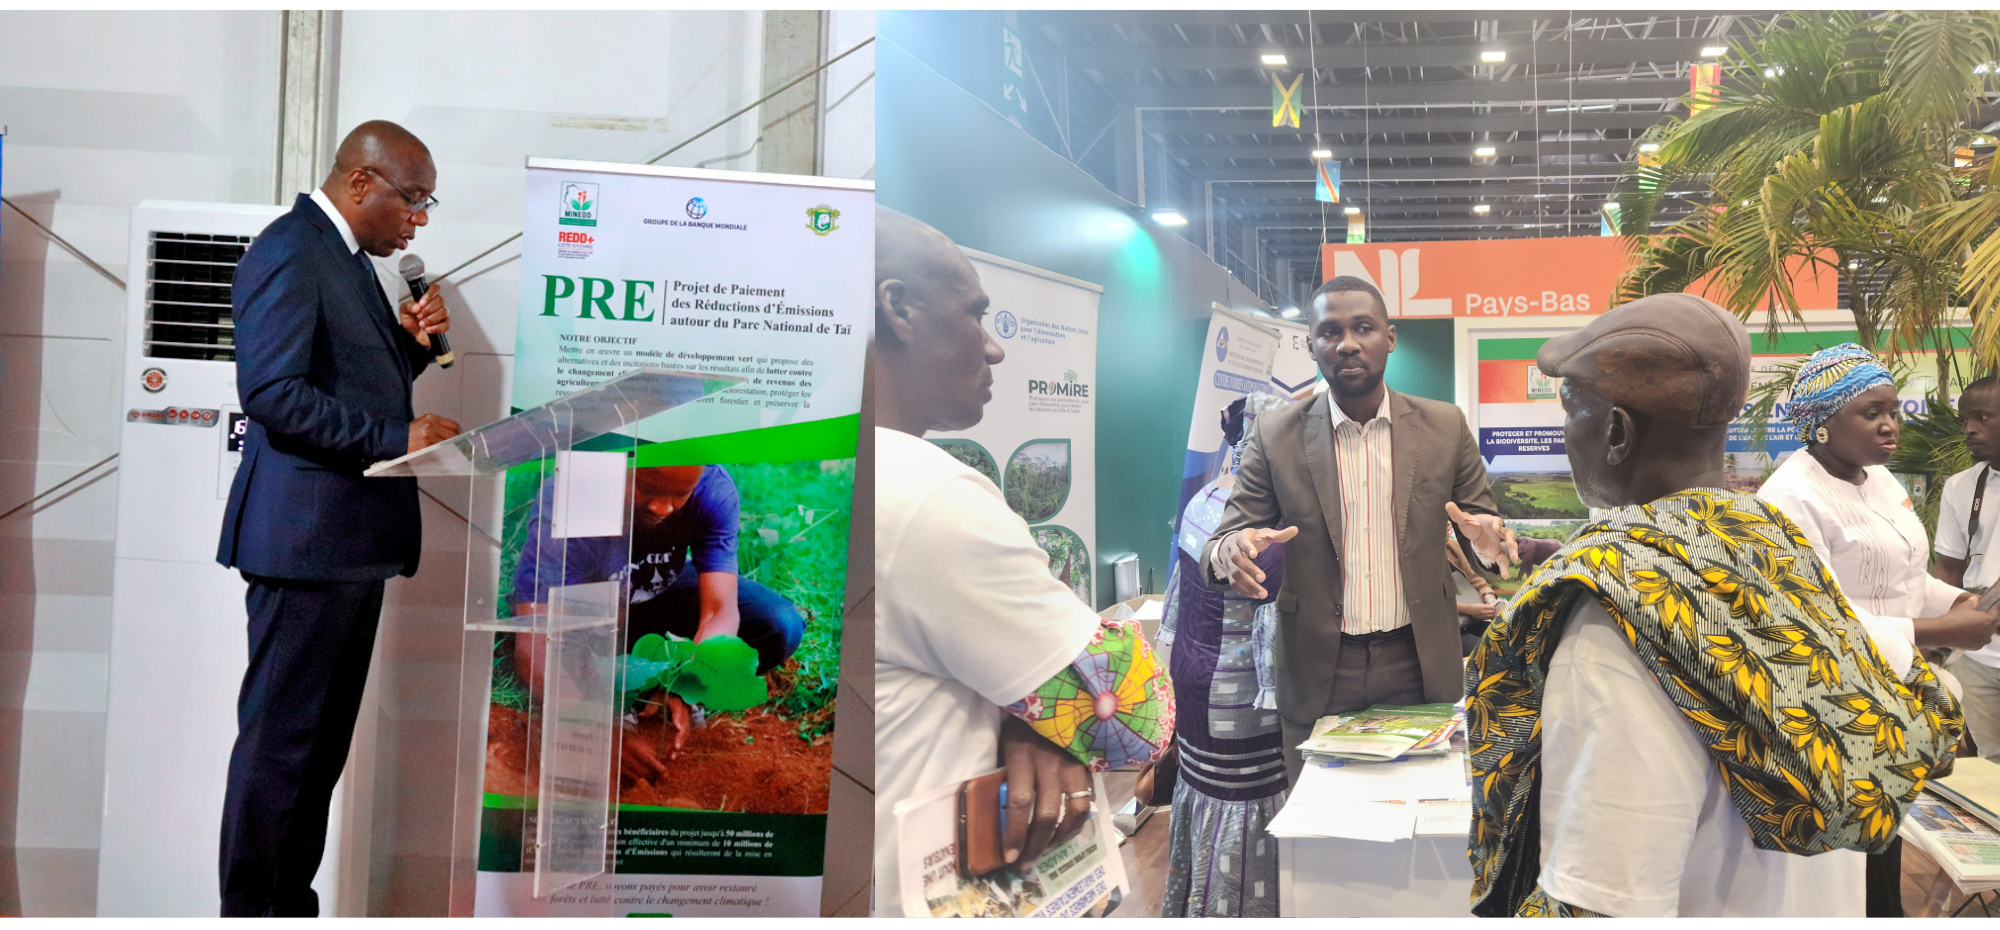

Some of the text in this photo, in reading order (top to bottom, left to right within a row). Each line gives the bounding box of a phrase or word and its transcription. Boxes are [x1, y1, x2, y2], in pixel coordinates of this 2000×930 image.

[643, 218, 669, 226] GROUPE
[669, 219, 678, 227] DE
[687, 220, 714, 229] BANQUE
[715, 223, 748, 231] MONDIALE
[558, 231, 595, 244] REDD+
[673, 280, 786, 299] Projet de Paiement
[538, 274, 656, 323] PRE
[1466, 291, 1591, 317] Pays-Bas
[671, 297, 691, 310] des
[694, 298, 761, 314] Réductions
[670, 316, 852, 336] autour du Parc National de Taï
[1020, 316, 1050, 330] Organisation
[1051, 322, 1060, 331] des
[1060, 322, 1078, 335] Nations
[1020, 326, 1033, 335] pour
[560, 333, 638, 345] NOTRE OBJECTIF
[1020, 333, 1028, 341] et
[559, 345, 583, 354] Mettre
[635, 349, 663, 358] modèle
[665, 350, 675, 358] de
[678, 351, 735, 363] développement
[738, 355, 753, 363] vert
[756, 357, 768, 365] qui
[770, 358, 799, 367] propose
[801, 358, 814, 366] des
[557, 366, 564, 374] le
[568, 367, 614, 378] changement
[558, 355, 599, 366] alternatives
[600, 358, 608, 366] et
[609, 358, 621, 367] des
[622, 359, 660, 368] incitations
[660, 360, 684, 369] basées
[698, 362, 709, 371] les
[709, 364, 740, 374] résultats
[741, 366, 755, 374] afin
[766, 366, 788, 375] lutter
[788, 368, 813, 377] contre
[753, 377, 812, 388] de revenus des
[1028, 380, 1090, 398] PROMIRE
[770, 389, 800, 399] protéger
[801, 390, 812, 398] les
[720, 396, 749, 406] forestier
[753, 398, 761, 406] et
[765, 399, 799, 408] préserver
[803, 401, 811, 409] la
[1492, 430, 1524, 438] PROTEGER
[1728, 434, 1738, 442] DE
[1495, 437, 1540, 446] BIODIVERSITE,
[1973, 497, 1981, 512] EOS
[623, 828, 669, 837] bénéficiaires
[670, 829, 679, 837] du
[679, 829, 700, 838] projet
[725, 829, 734, 837] 50
[735, 830, 764, 838] millions
[764, 830, 774, 838] de
[628, 838, 658, 846] effective
[677, 839, 710, 847] minimum
[711, 839, 721, 847] de
[723, 839, 732, 847] 10
[733, 840, 762, 848] millions
[763, 840, 774, 848] de
[670, 850, 682, 858] qui
[684, 849, 721, 858] résulteront
[723, 850, 733, 858] de
[735, 850, 742, 858] la
[744, 850, 762, 858] mise
[763, 851, 773, 859] en
[578, 881, 602, 892] PRE,
[638, 882, 666, 895] payés
[667, 884, 691, 894] pour
[692, 883, 718, 893] avoir
[719, 883, 758, 893] restauré
[549, 893, 577, 905] forêts
[578, 894, 589, 904] et
[613, 895, 644, 905] contre
[645, 895, 655, 905] le
[656, 895, 713, 908] changement
[714, 895, 762, 908] climatique
